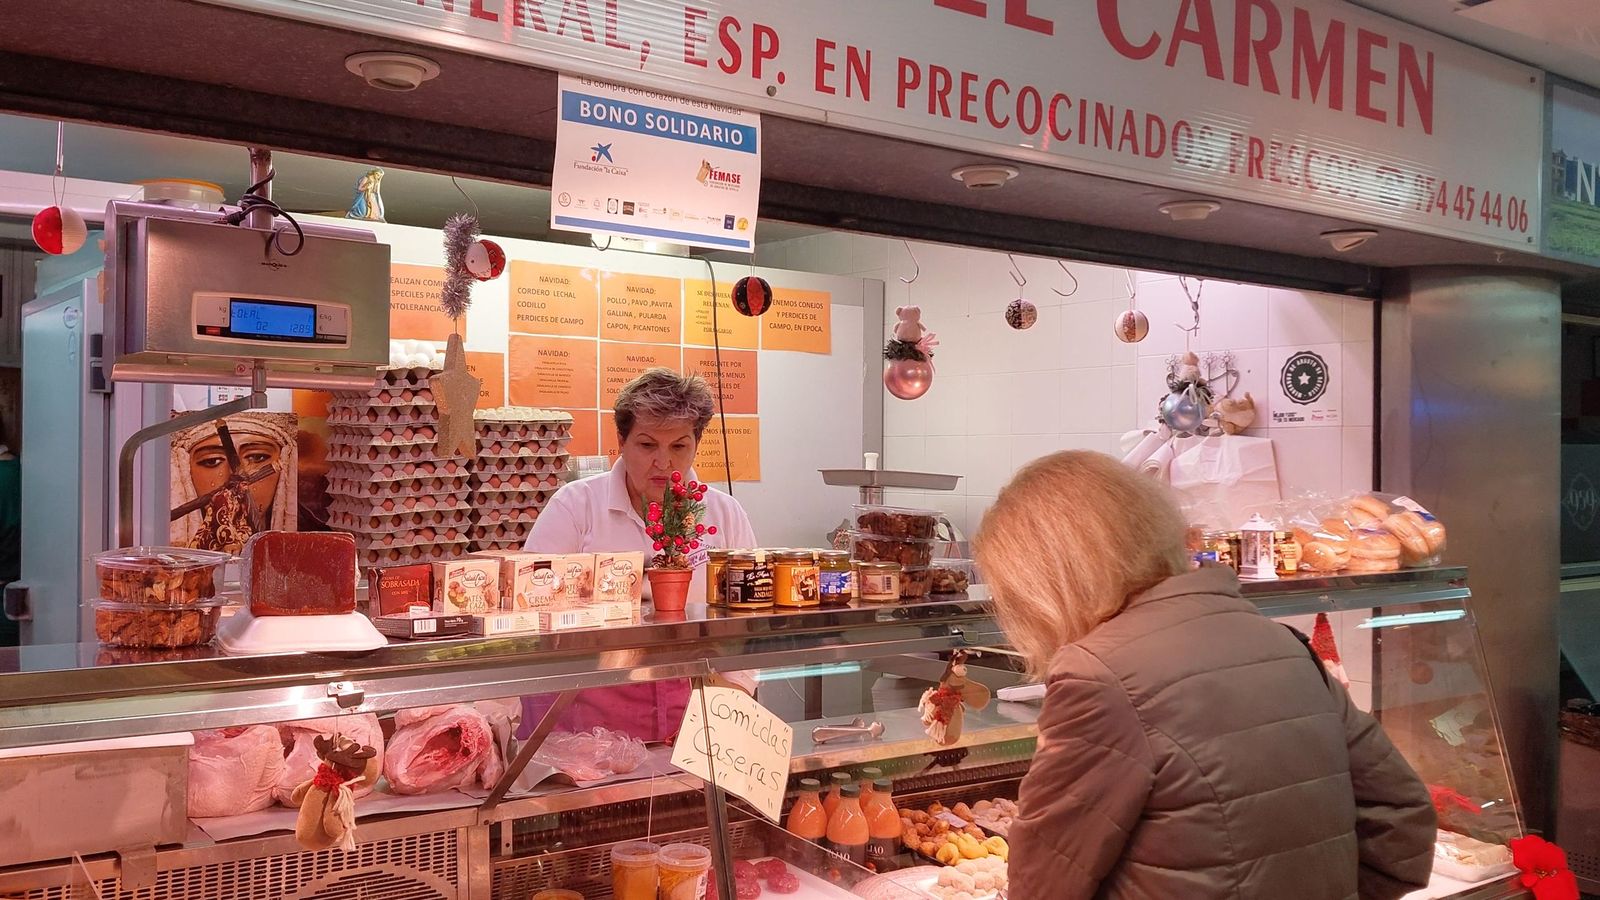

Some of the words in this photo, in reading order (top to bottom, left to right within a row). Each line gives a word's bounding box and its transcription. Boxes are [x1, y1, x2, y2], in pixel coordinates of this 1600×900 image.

[1097, 0, 1436, 135] CARMEN
[594, 79, 626, 94] compra
[629, 87, 644, 96] con
[680, 97, 690, 106] de
[580, 101, 638, 126] BONO
[645, 113, 743, 146] SOLIDARIO
[684, 6, 786, 84] ESP.
[814, 38, 871, 102] EN
[897, 56, 1213, 168] PRECOCINADOS
[1453, 184, 1475, 221] 45
[1480, 190, 1503, 227] 44
[1507, 196, 1528, 233] 06
[709, 169, 741, 184] FEMASE
[1577, 159, 1600, 206] N
[517, 287, 550, 296] CORDERO
[553, 290, 576, 299] LECHAL
[517, 300, 546, 309] CODILLO
[607, 296, 627, 305] POLLO
[798, 301, 824, 310] CONEJOS
[607, 309, 633, 318] GALLINA
[781, 312, 808, 320] PERDICES
[516, 314, 549, 323] PERDICES
[559, 317, 584, 325] CAMPO
[632, 324, 671, 333] PICANTONES
[769, 322, 793, 331] CAMPO,
[381, 579, 421, 589] SOBRASADA
[710, 693, 788, 758] Comidas
[693, 725, 782, 792] Caseras
